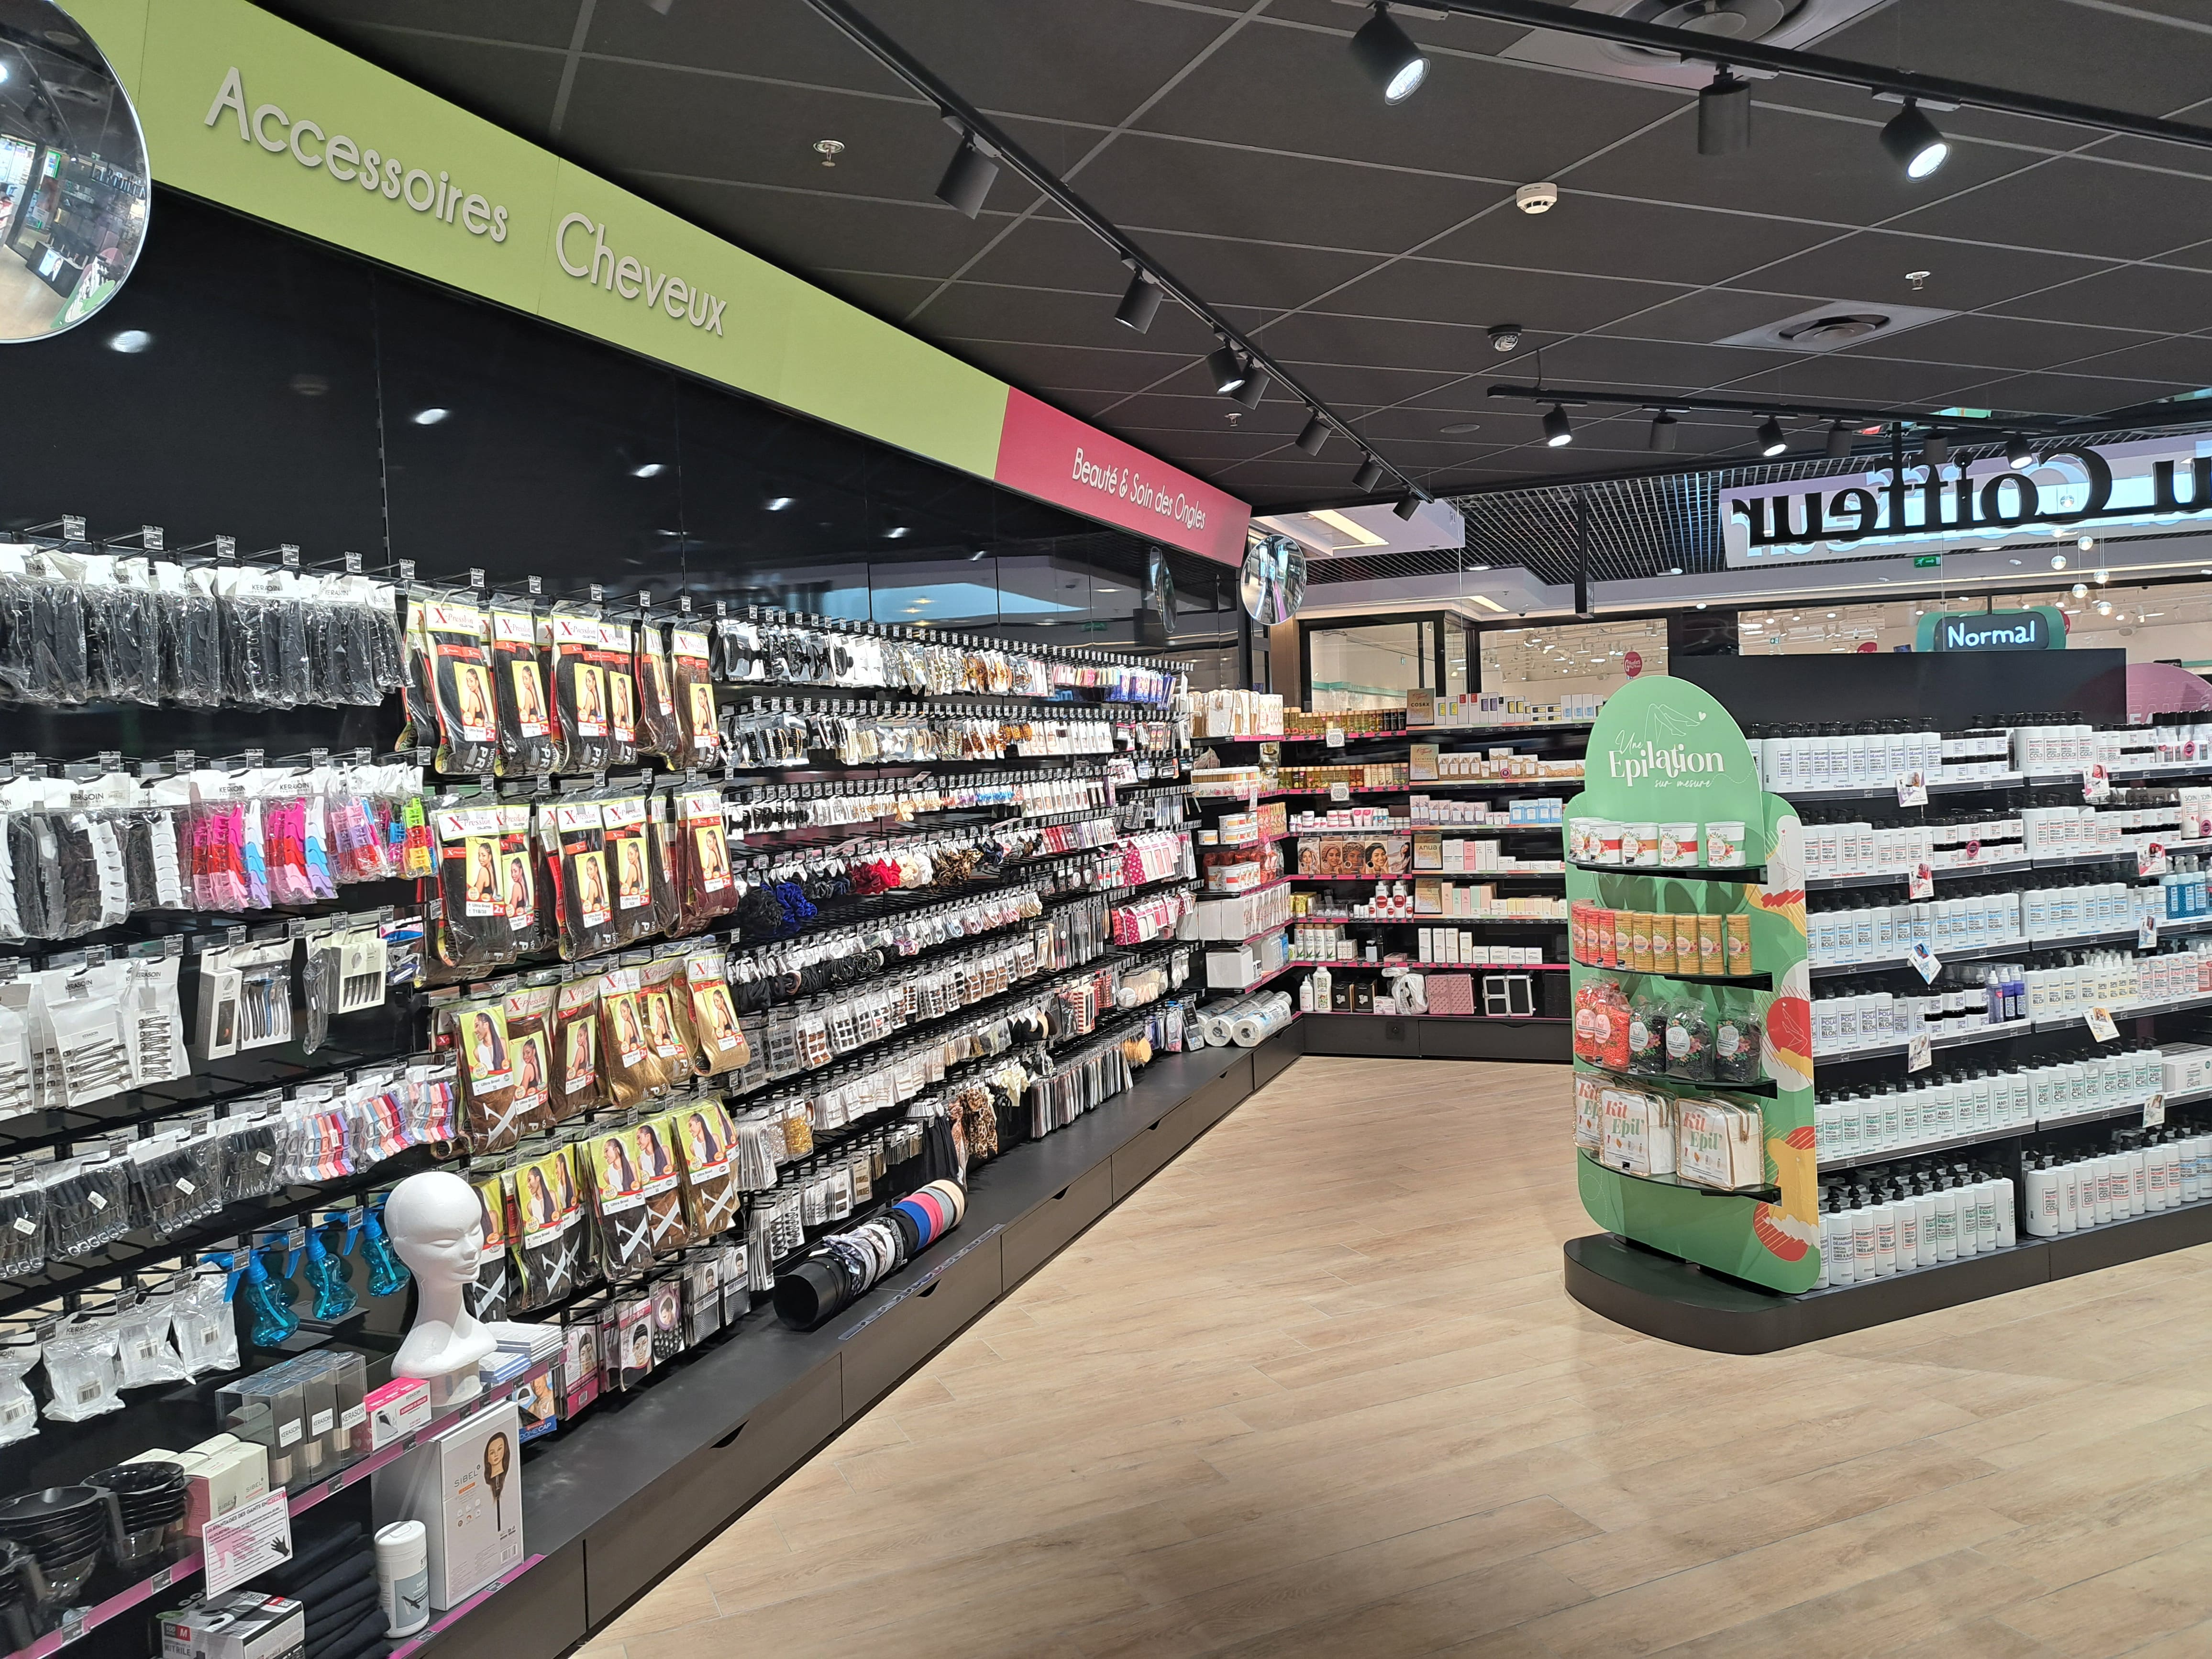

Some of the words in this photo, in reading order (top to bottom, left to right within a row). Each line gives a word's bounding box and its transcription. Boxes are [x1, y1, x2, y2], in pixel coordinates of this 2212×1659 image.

[204, 66, 509, 243] Accessoires
[555, 212, 727, 337] Cheveux
[1072, 447, 1118, 496] Beauté
[1119, 468, 1129, 498] &
[1130, 473, 1154, 509] Soin
[1154, 485, 1173, 517] des
[1174, 493, 1206, 531] Ongles
[1947, 620, 2036, 649] Normal
[487, 730, 495, 739] 2x
[542, 724, 550, 733] 2x
[599, 727, 607, 735] 2x
[628, 732, 634, 740] 2x
[711, 737, 718, 745] 2x
[1615, 730, 1644, 755] Une
[1608, 741, 1725, 787] Epilation
[1654, 779, 1672, 789] sur
[1676, 779, 1713, 789] mesure
[640, 895, 649, 903] 2x
[603, 912, 610, 920] 2x
[65, 979, 93, 991] KERASOIN
[641, 1050, 647, 1058] 2x
[586, 1074, 594, 1082] 2x
[1605, 1100, 1628, 1119] Kit
[1683, 1111, 1707, 1132] Kit
[66, 1322, 100, 1334] KERASOIN
[406, 1389, 421, 1400] KERASOIN
[342, 1405, 365, 1423] KERASOIN
[313, 1415, 332, 1427] KERASOIN
[281, 1425, 300, 1438] KERASOIN
[454, 1469, 478, 1487] SIBEL
[246, 1481, 262, 1493] SIBEL
[212, 1515, 238, 1531] AVANTAGES
[246, 1505, 261, 1515] GANTS
[179, 1628, 188, 1638] M
[164, 1644, 191, 1656] NITRILE
